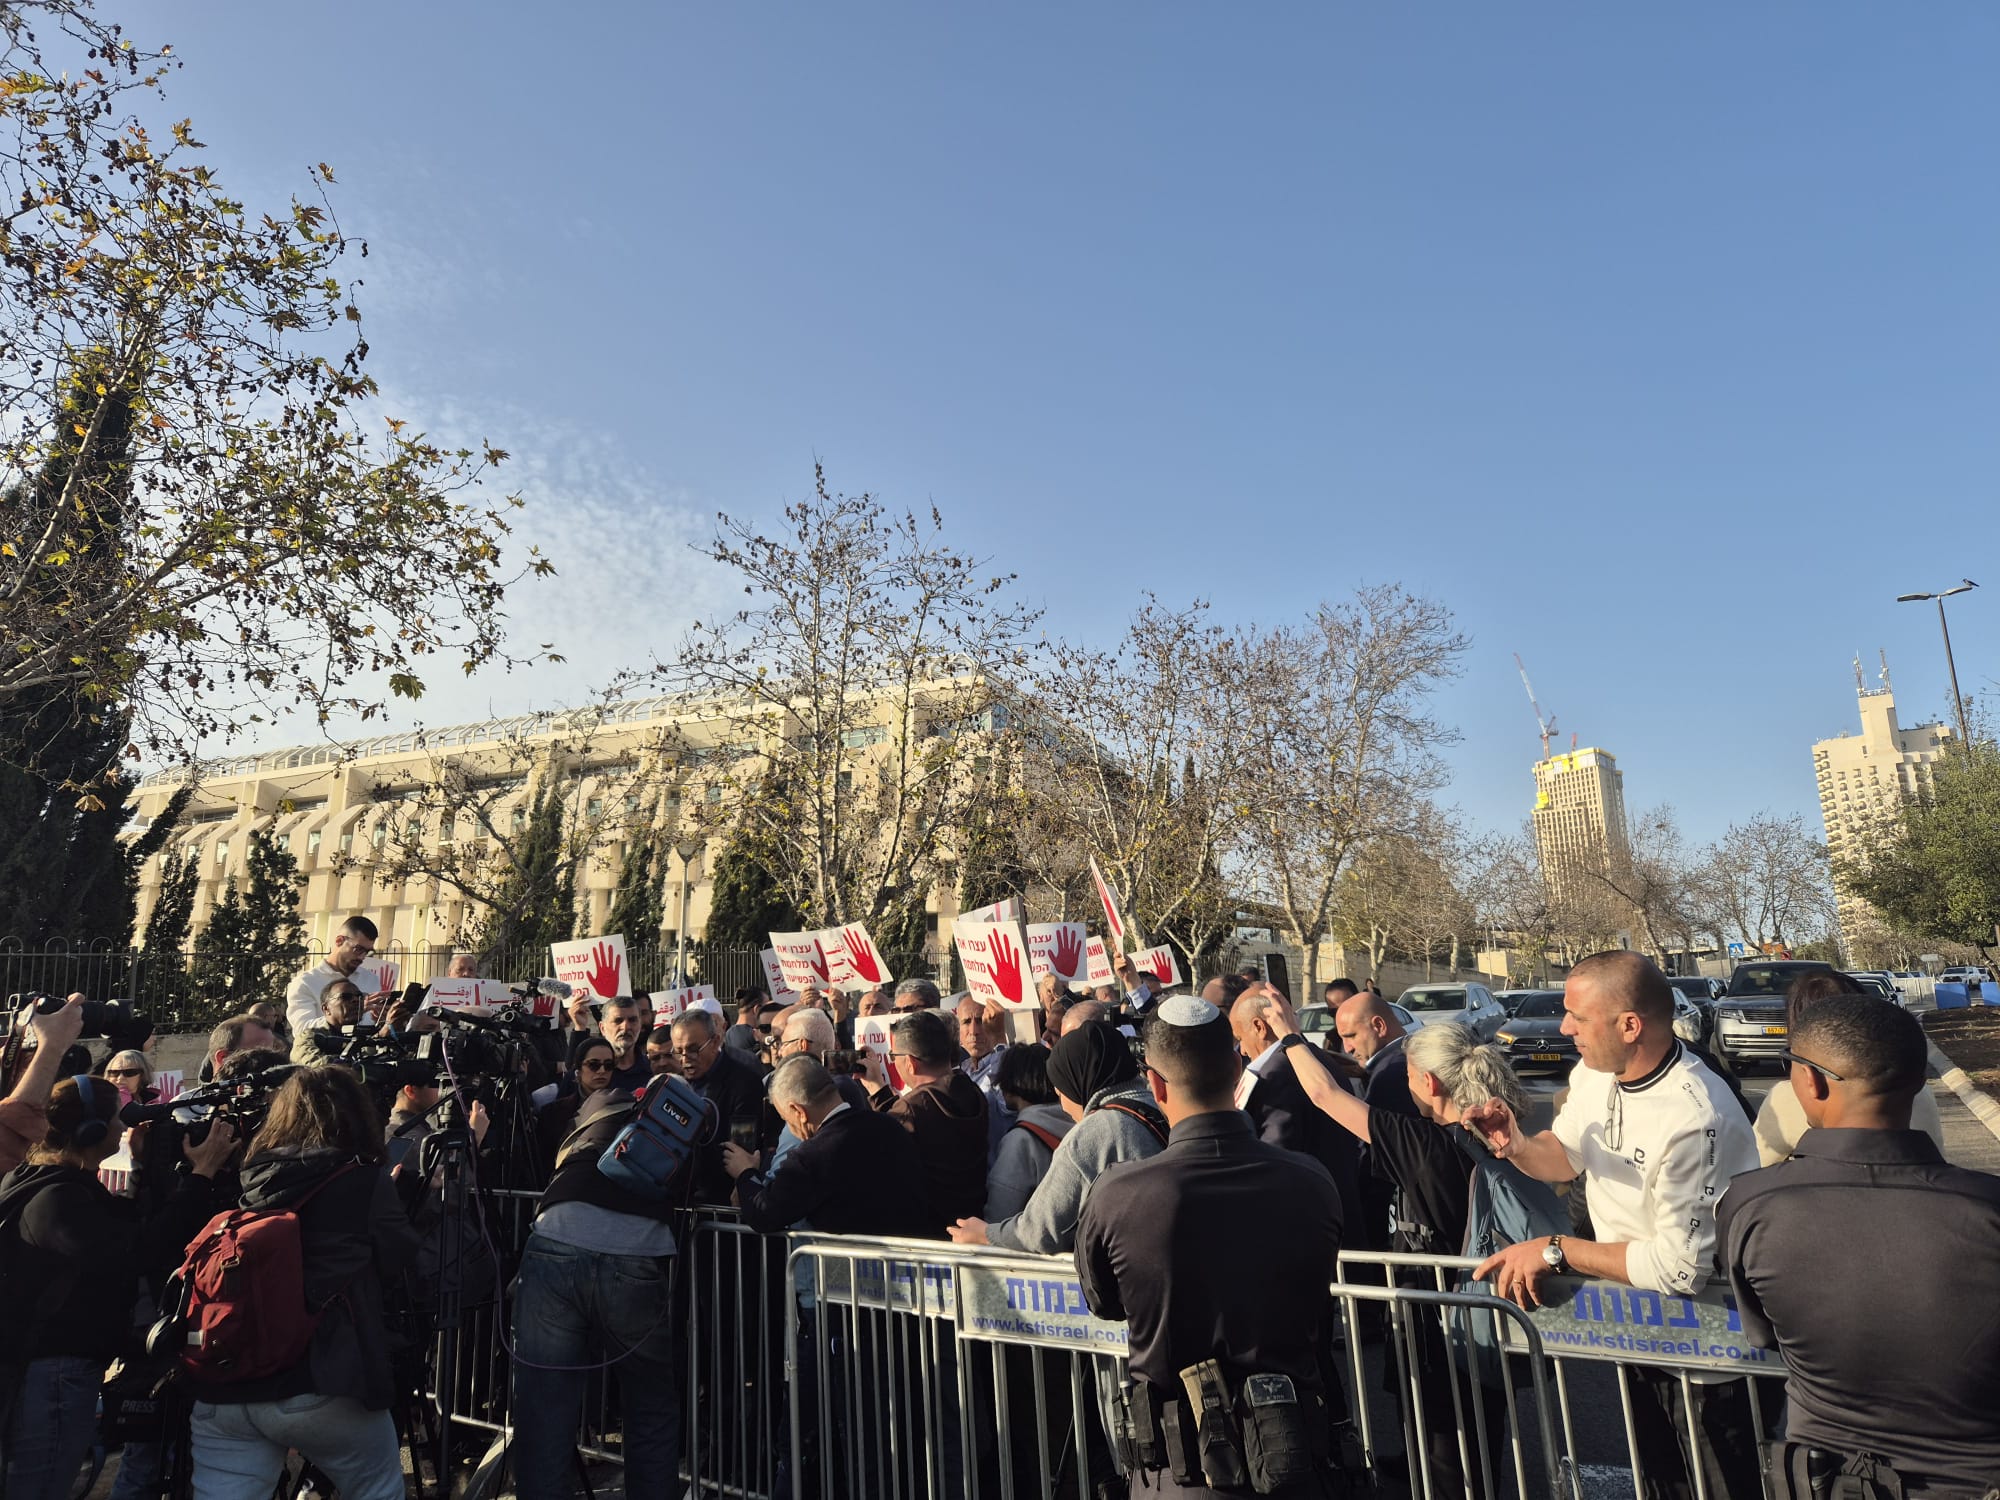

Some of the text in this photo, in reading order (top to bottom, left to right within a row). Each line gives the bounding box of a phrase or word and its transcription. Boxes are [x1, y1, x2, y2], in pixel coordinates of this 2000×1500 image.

[1028, 934, 1051, 944] עצרו
[790, 945, 811, 954] עצרו
[968, 940, 986, 952] עצרו
[1087, 943, 1103, 957] AHU
[568, 953, 588, 964] עצרו
[1090, 967, 1111, 979] CRIME
[869, 1033, 886, 1044] עצרו
[663, 1103, 688, 1126] LiveU
[1571, 1284, 1700, 1329] במות
[1521, 1327, 1767, 1362] ww.kstisrael.co.il
